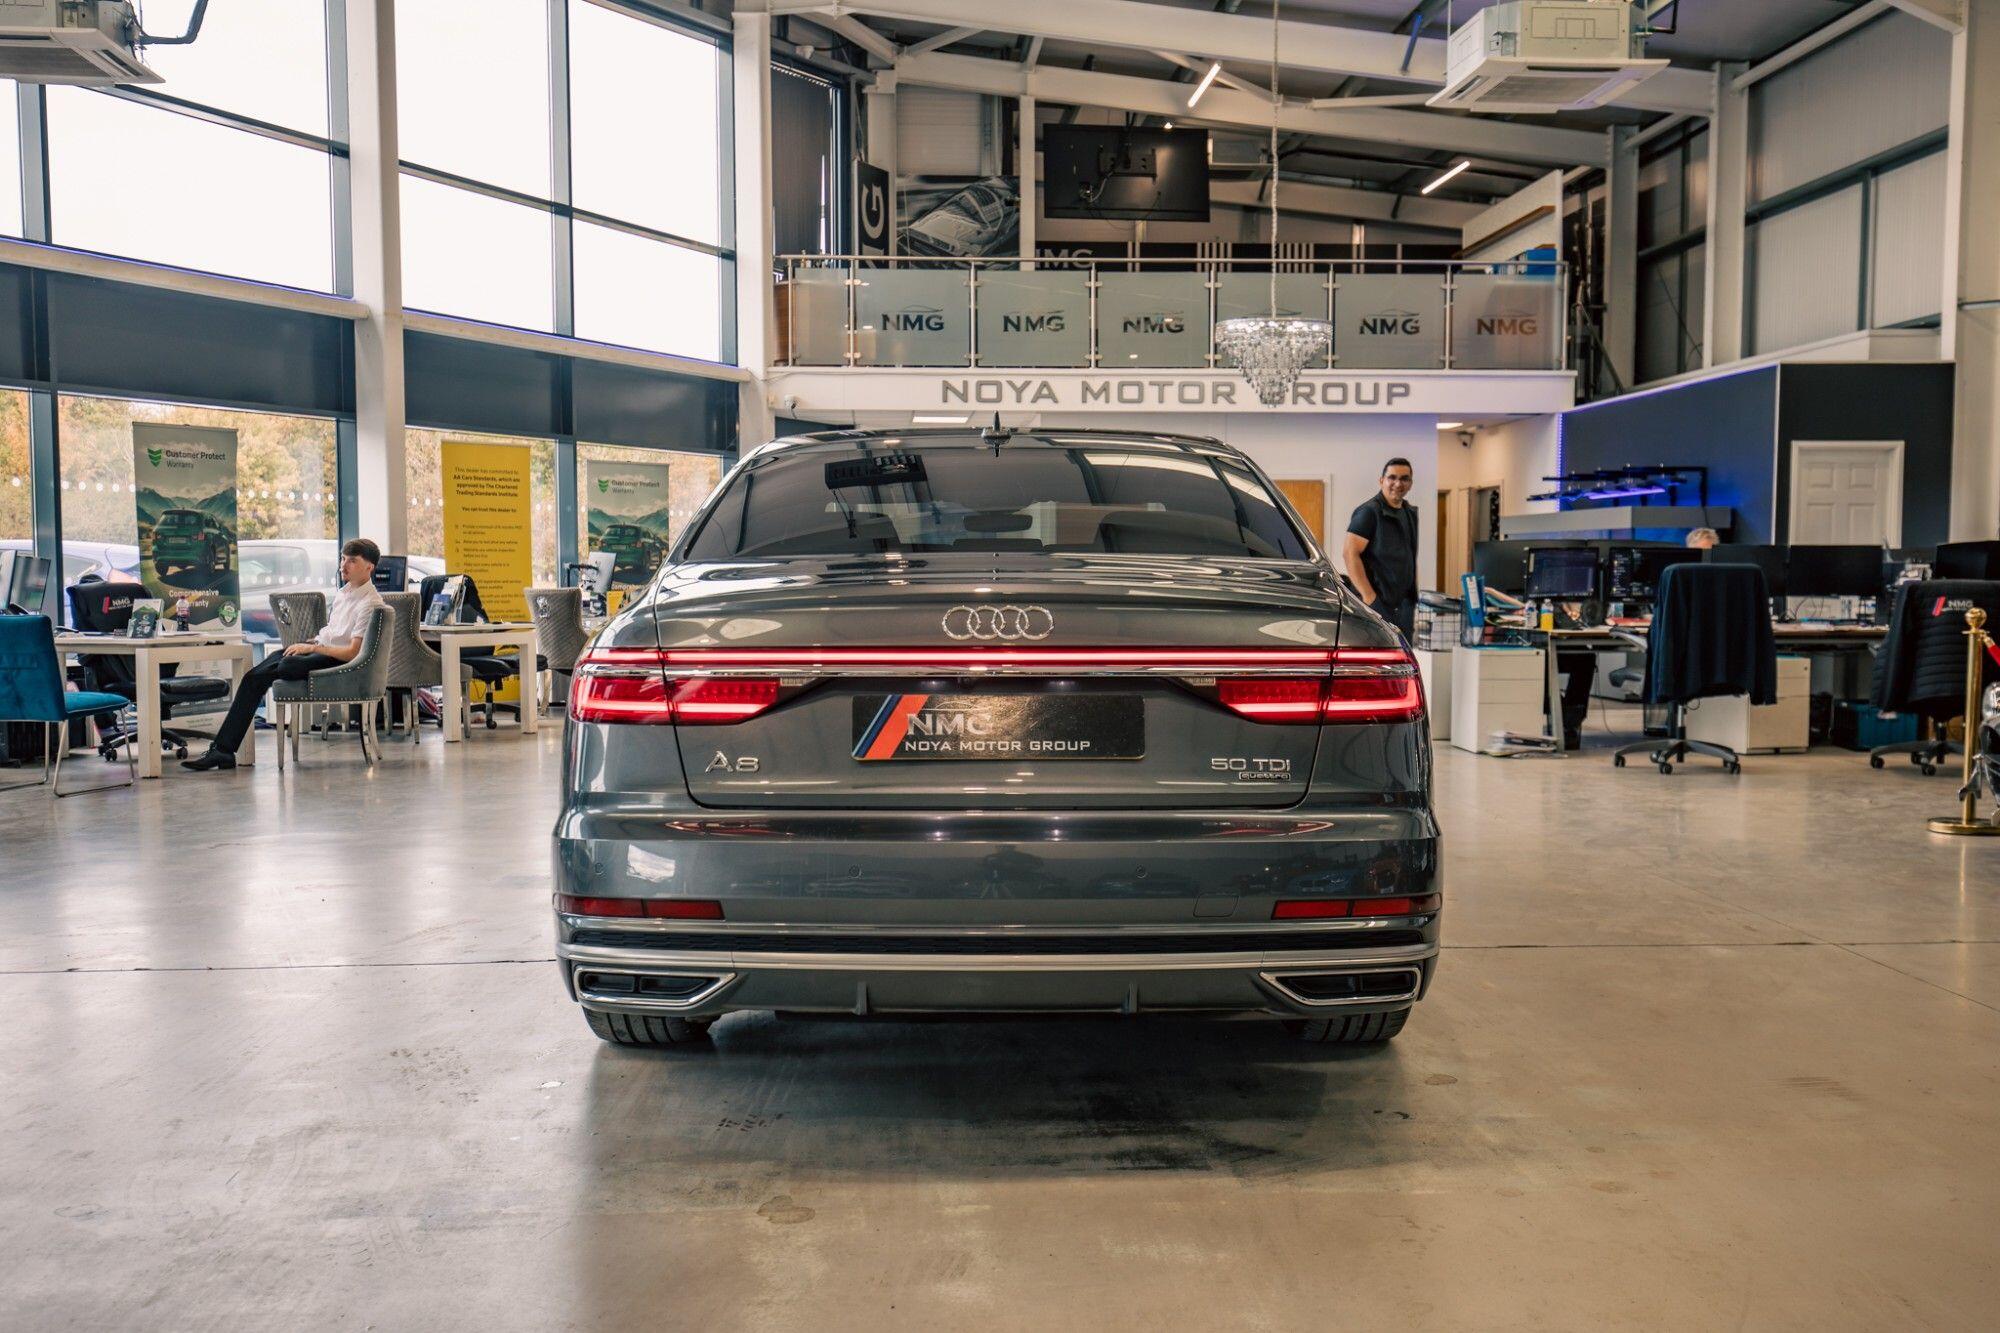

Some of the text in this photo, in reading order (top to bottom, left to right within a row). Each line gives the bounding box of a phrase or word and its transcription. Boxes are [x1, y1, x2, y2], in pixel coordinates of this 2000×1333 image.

[882, 314, 945, 332] NMG
[1003, 315, 1065, 333] NMG
[1122, 316, 1185, 333] NMG
[1359, 318, 1421, 335] NMG
[1476, 318, 1538, 336] NMG
[942, 380, 1411, 406] NOYA MOTOR ROUP
[165, 449, 226, 461] Customer Protect
[166, 460, 194, 469] Warranty
[906, 713, 994, 736] NMG
[905, 740, 1091, 751] NOYA MOTOR GROUP
[705, 750, 759, 774] A8
[1211, 758, 1291, 772] 50 TDI
[1241, 772, 1289, 780] quattro
